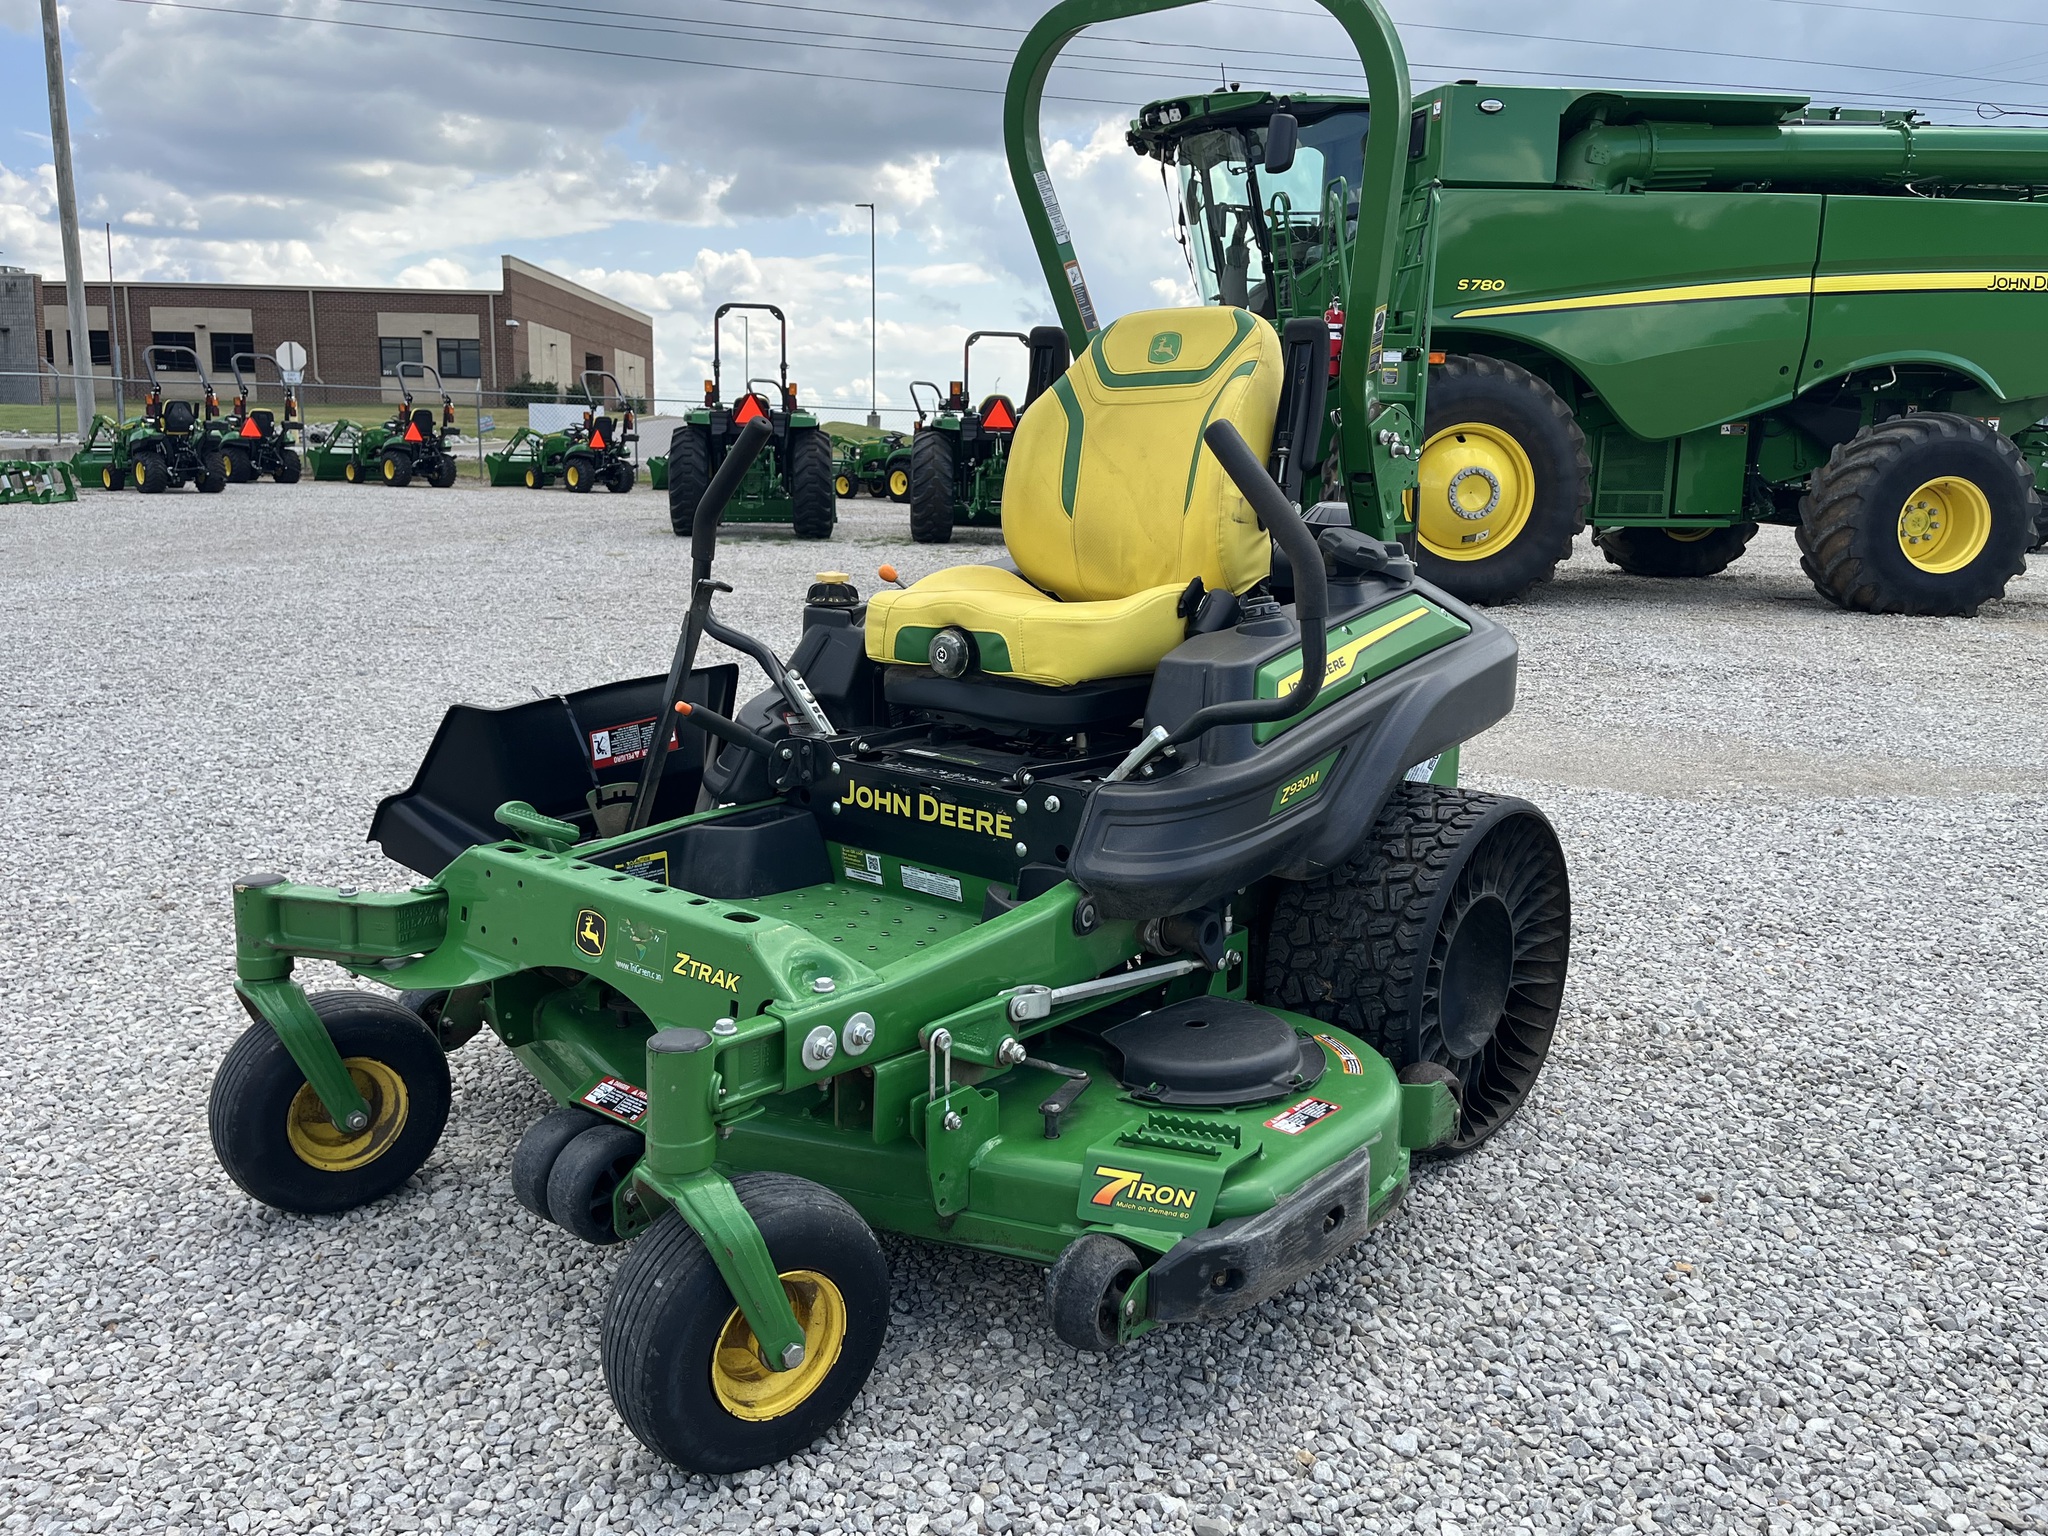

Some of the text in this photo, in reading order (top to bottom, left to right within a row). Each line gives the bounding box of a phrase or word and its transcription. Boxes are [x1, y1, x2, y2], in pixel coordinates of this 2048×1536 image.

[1457, 278, 1506, 291] S780
[1987, 274, 2048, 289] JOHN D
[1280, 770, 1320, 805] Z930M
[841, 779, 1013, 839] JOHN DEERE
[673, 952, 741, 993] ZTRAK
[1115, 1201, 1136, 1210] Mulch
[1148, 1206, 1178, 1217] Demand
